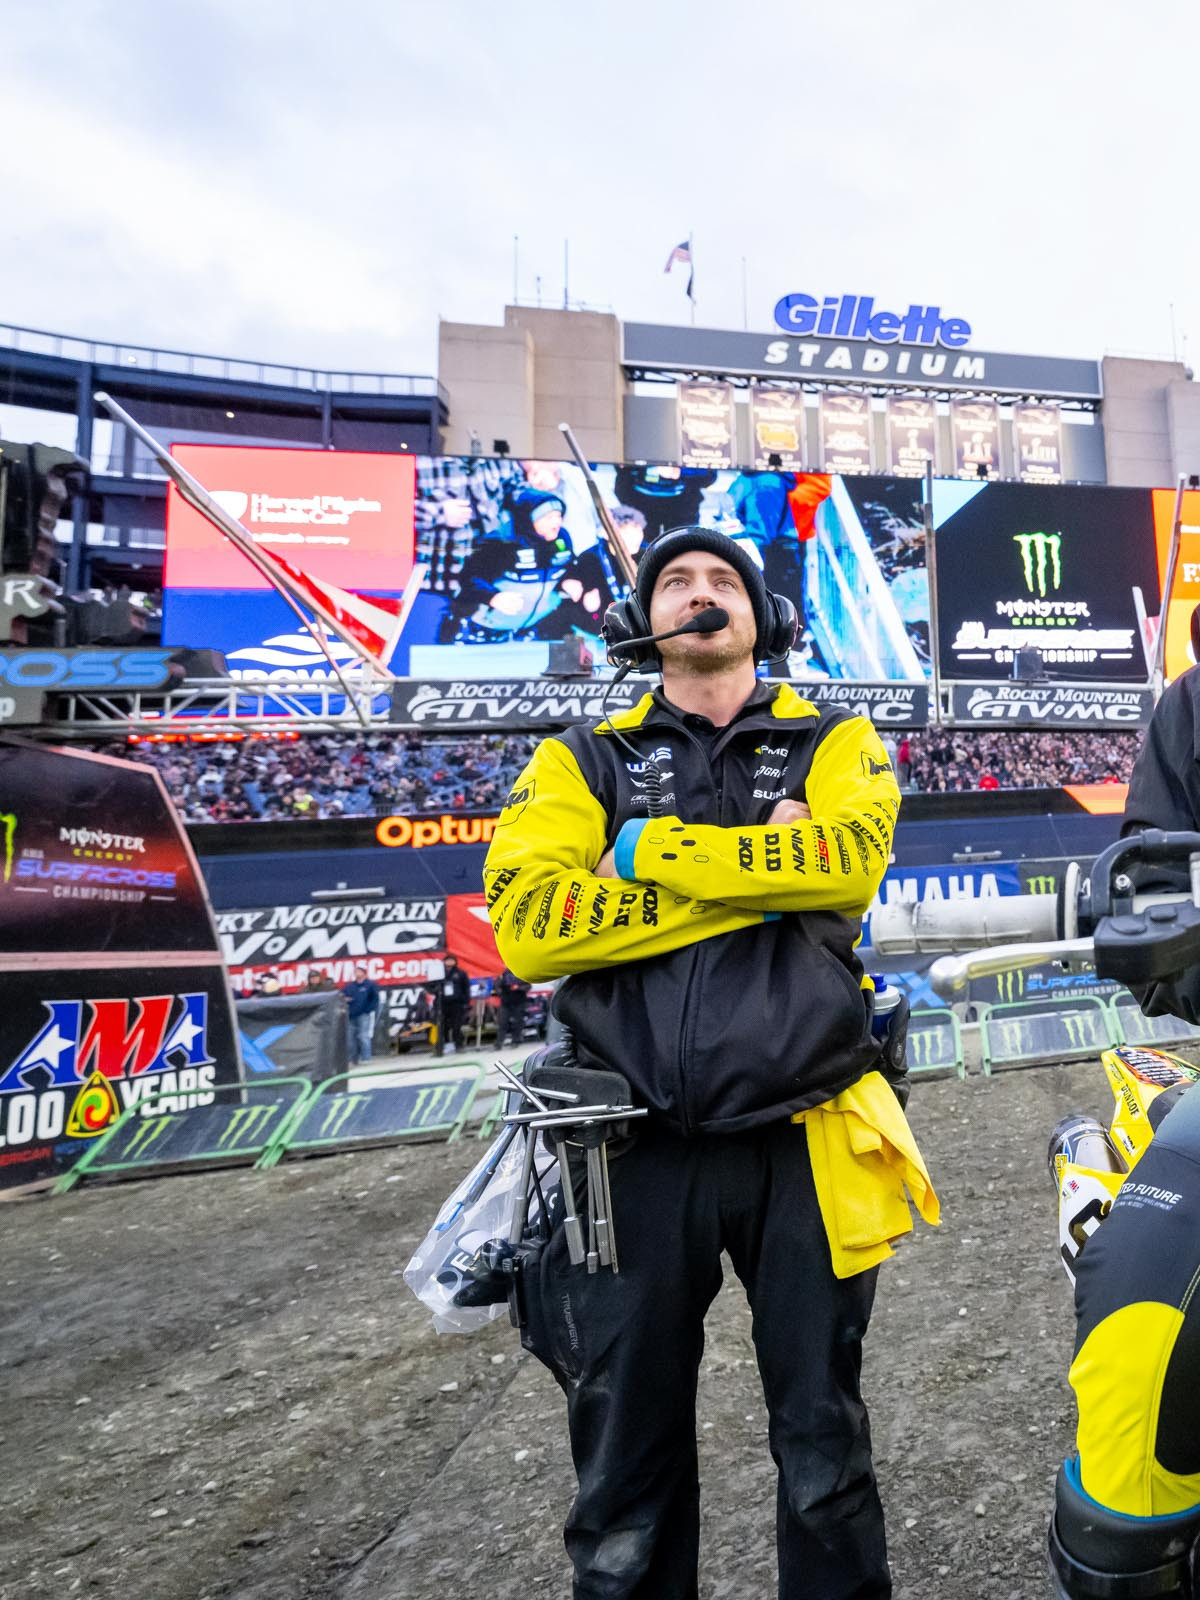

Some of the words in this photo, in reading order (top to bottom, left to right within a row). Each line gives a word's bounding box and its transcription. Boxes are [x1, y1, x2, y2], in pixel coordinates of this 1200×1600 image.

[773, 292, 973, 349] Gillette
[763, 340, 986, 380] STADIUM
[995, 598, 1091, 618] MONSTER
[1011, 617, 1078, 626] ENERGY
[444, 681, 520, 699] ROCKY
[521, 680, 635, 698] MOUNTAIN
[815, 684, 915, 701] MOUNTAIN
[995, 686, 1051, 701] ROCKY
[1052, 688, 1142, 705] MOUNTAIN
[625, 746, 672, 773] WS
[60, 826, 146, 853] MONSTER
[73, 848, 134, 861] ENERGY
[15, 859, 177, 889] SUPERCROSS
[53, 885, 147, 903] CHAMPIONSHIP
[268, 901, 446, 932] MOUNTAIN
[0, 992, 217, 1094] AMA
[119, 1065, 216, 1118] YEARS
[1133, 1183, 1183, 1205] FUTURE
